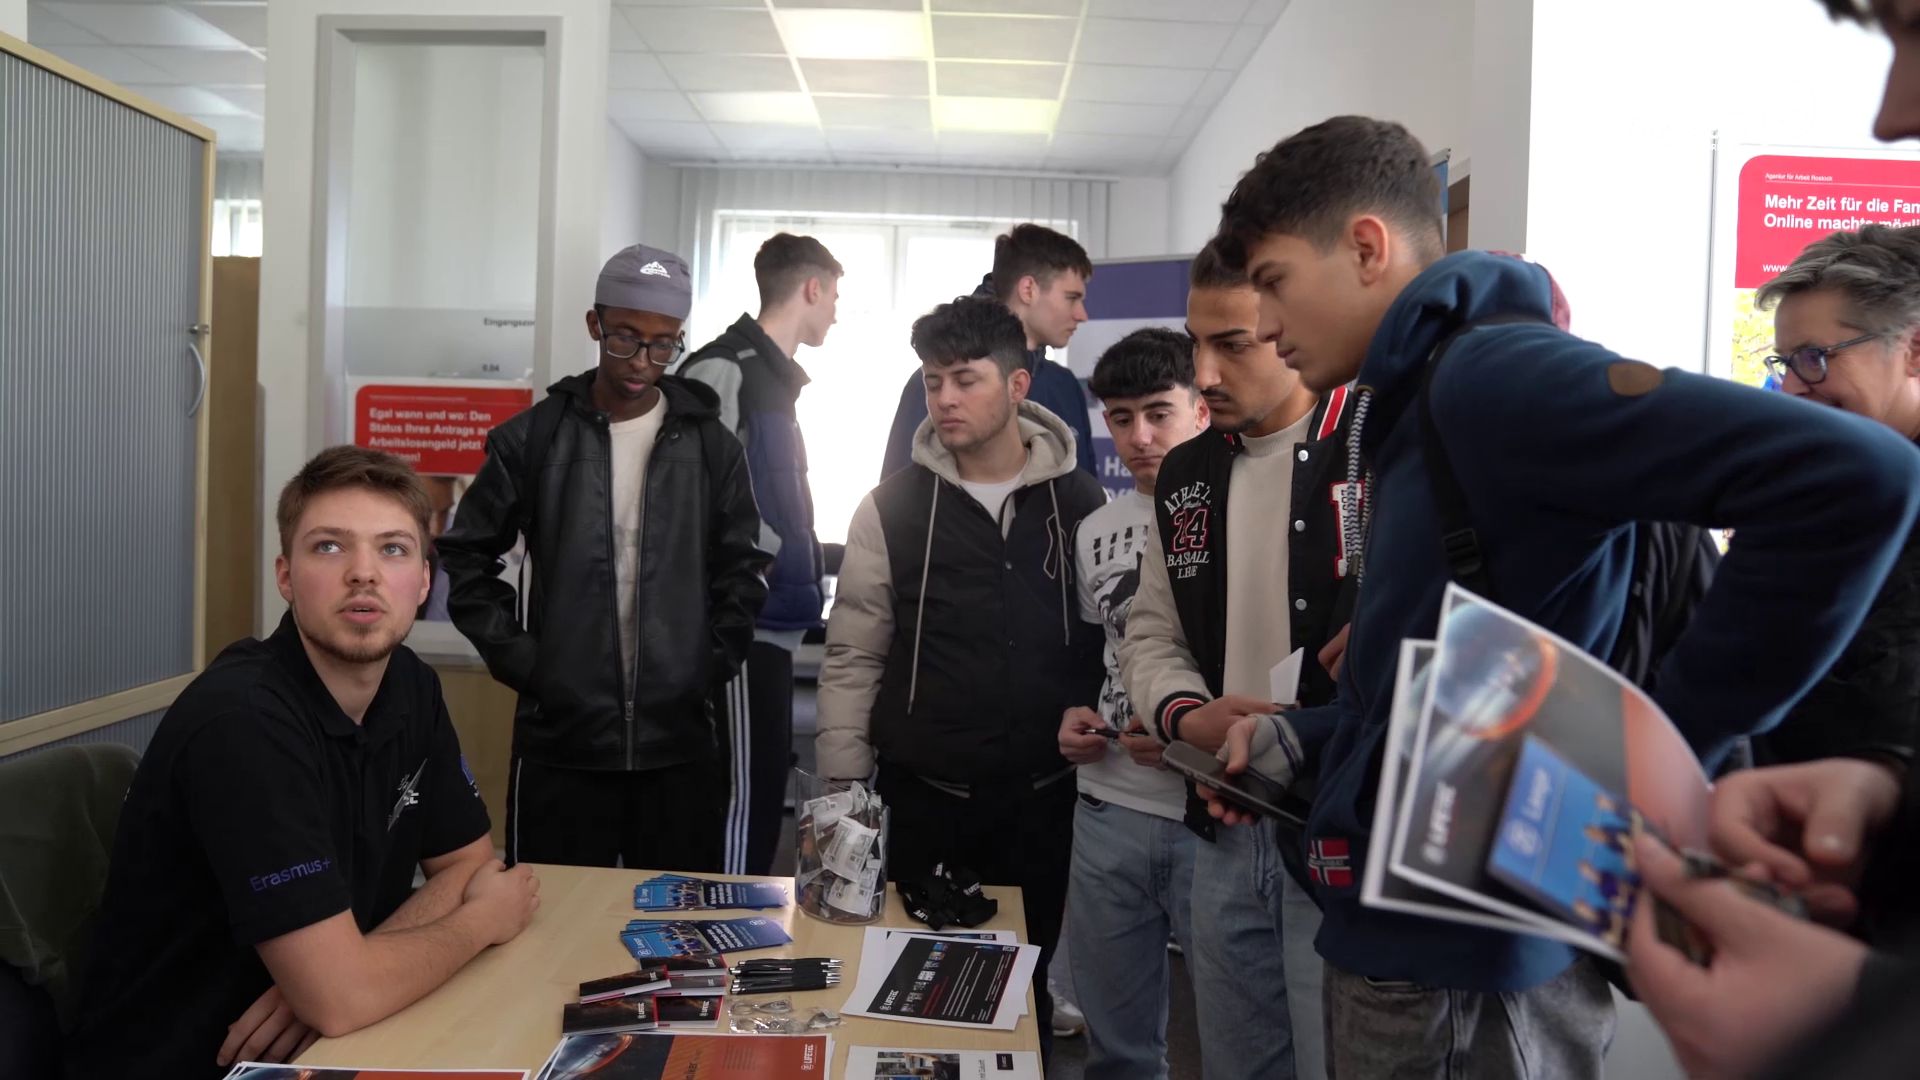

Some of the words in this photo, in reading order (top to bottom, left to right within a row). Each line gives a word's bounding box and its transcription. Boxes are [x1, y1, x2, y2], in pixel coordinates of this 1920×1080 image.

[1765, 194, 1803, 209] Mehr
[1806, 196, 1836, 210] Zeit
[1840, 197, 1863, 211] für
[1866, 198, 1889, 212] die
[1764, 213, 1813, 229] Online
[370, 408, 393, 421] Egal
[395, 411, 424, 420] wann
[426, 409, 446, 420] und
[448, 412, 467, 421] wo:
[470, 411, 491, 421] Den
[370, 422, 403, 434] Status
[405, 423, 432, 434] Ihres
[434, 424, 475, 437] Antrags
[370, 436, 457, 450] Arbeitslosengeld
[458, 439, 482, 451] jetzt
[1173, 507, 1208, 552] 24
[250, 858, 331, 892] Erasmus+
